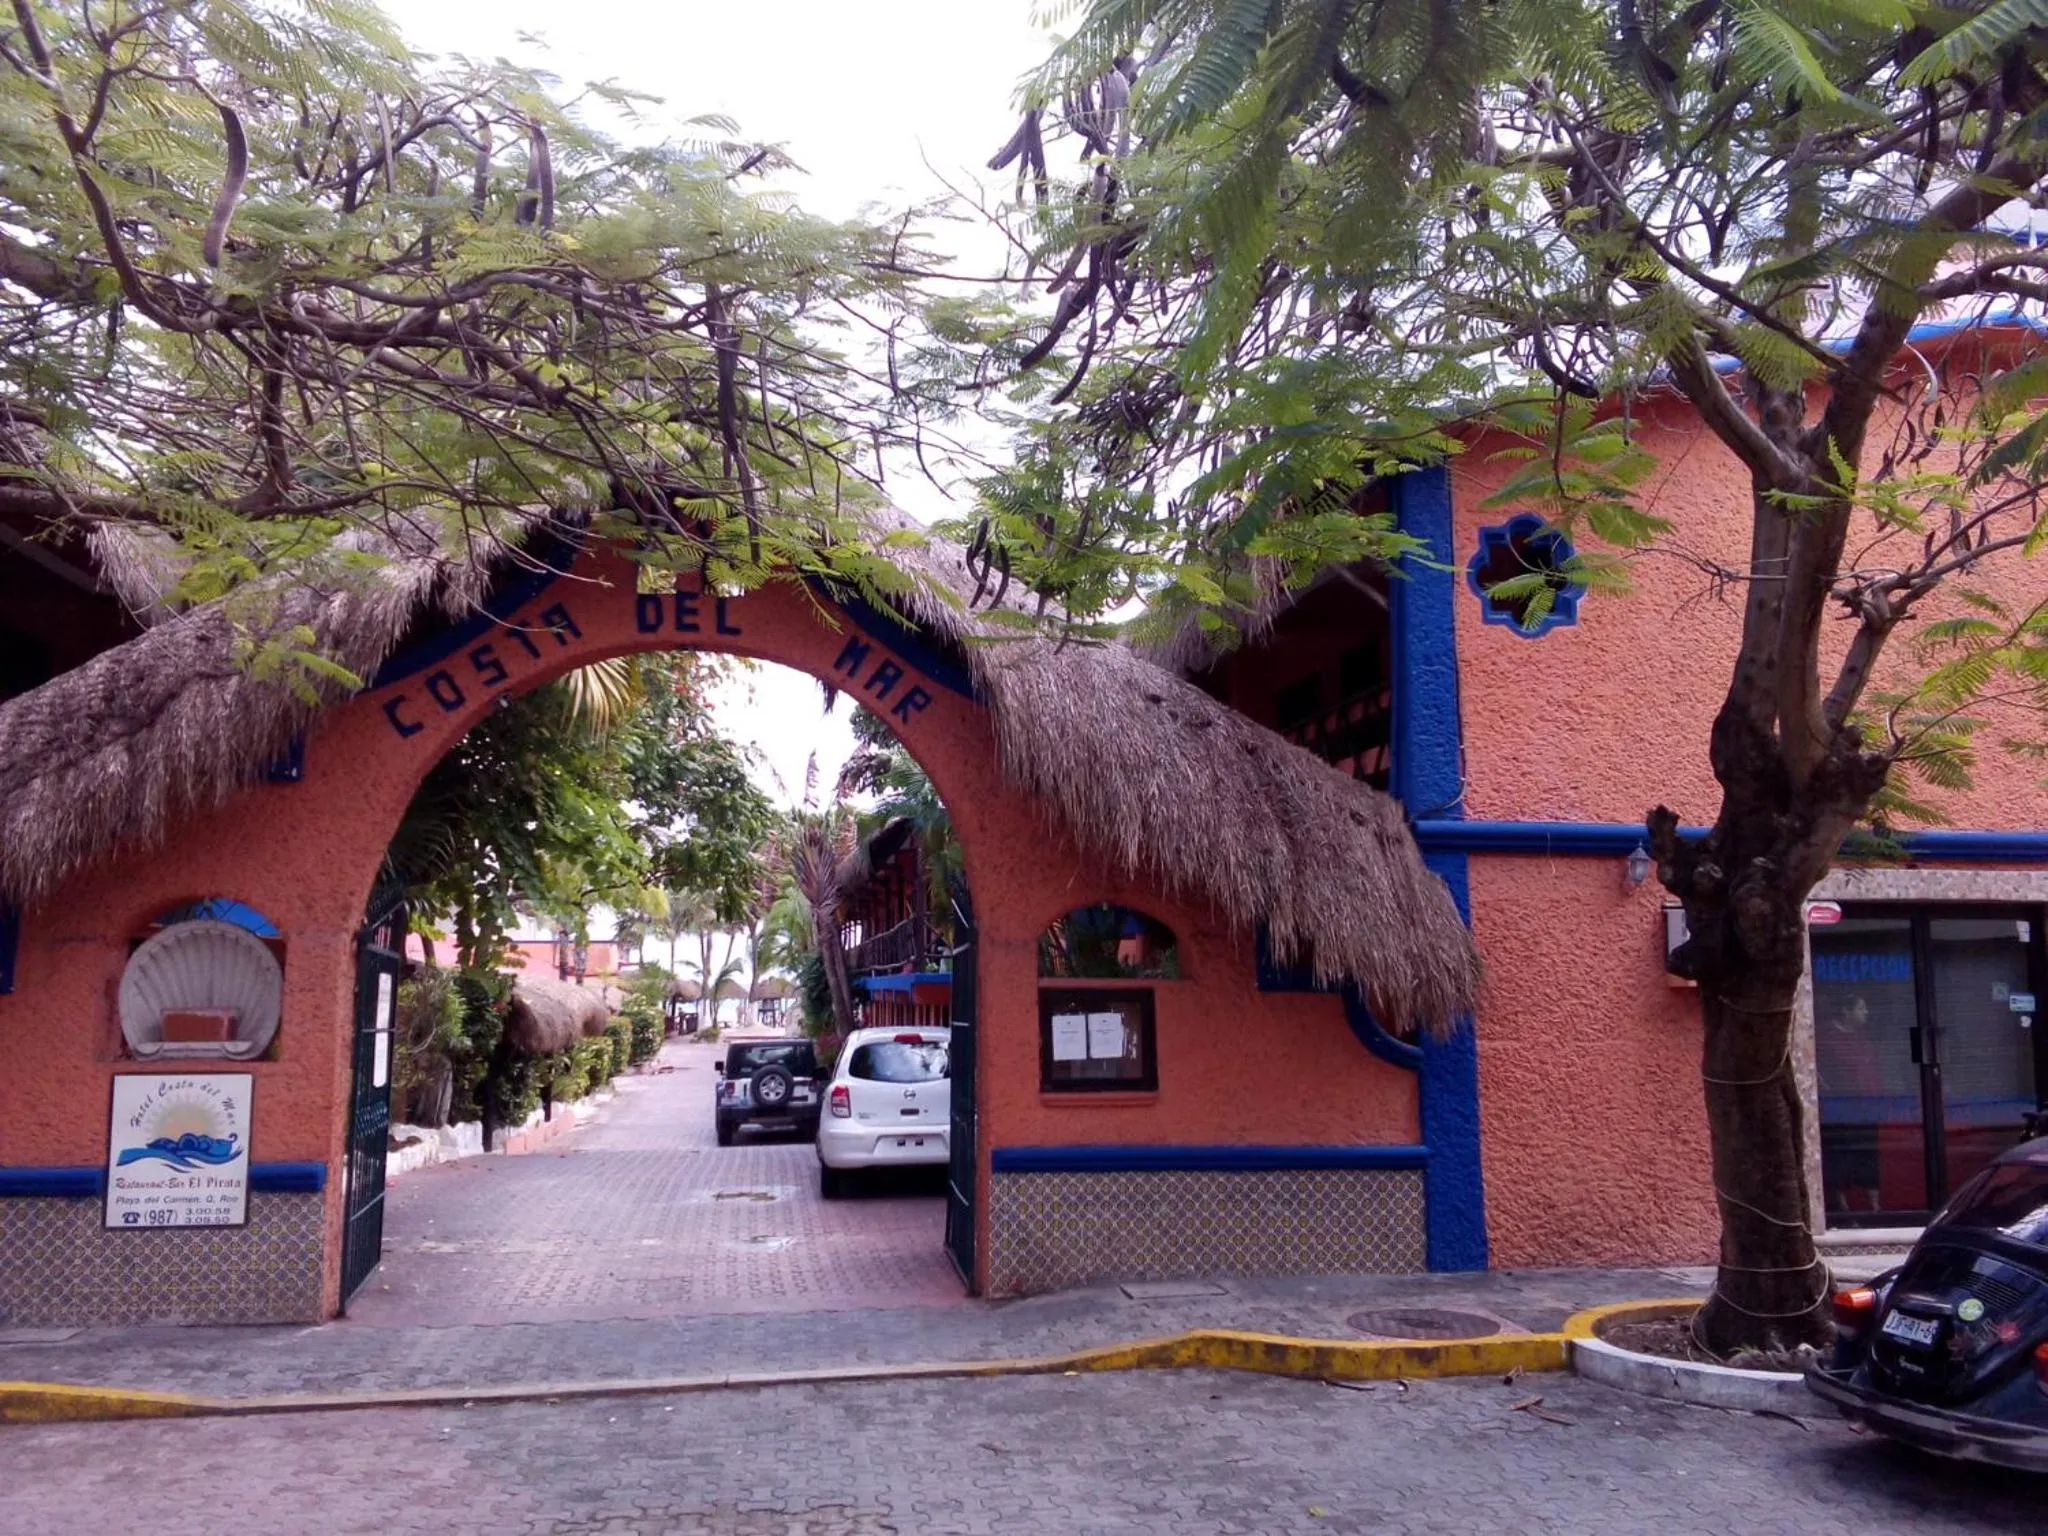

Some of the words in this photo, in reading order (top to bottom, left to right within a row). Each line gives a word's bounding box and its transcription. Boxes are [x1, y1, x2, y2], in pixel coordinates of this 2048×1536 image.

[383, 604, 582, 738] COSTA
[636, 592, 742, 636] DEL
[833, 635, 932, 725] MAR
[130, 1094, 154, 1128] Hotel
[158, 1080, 194, 1098] Costa
[200, 1082, 222, 1097] del
[221, 1096, 237, 1126] Mar
[188, 1177, 201, 1189] El
[206, 1177, 241, 1189] Pirata
[115, 1195, 140, 1207] Playa
[144, 1195, 160, 1205] del
[143, 1209, 179, 1225] (987)
